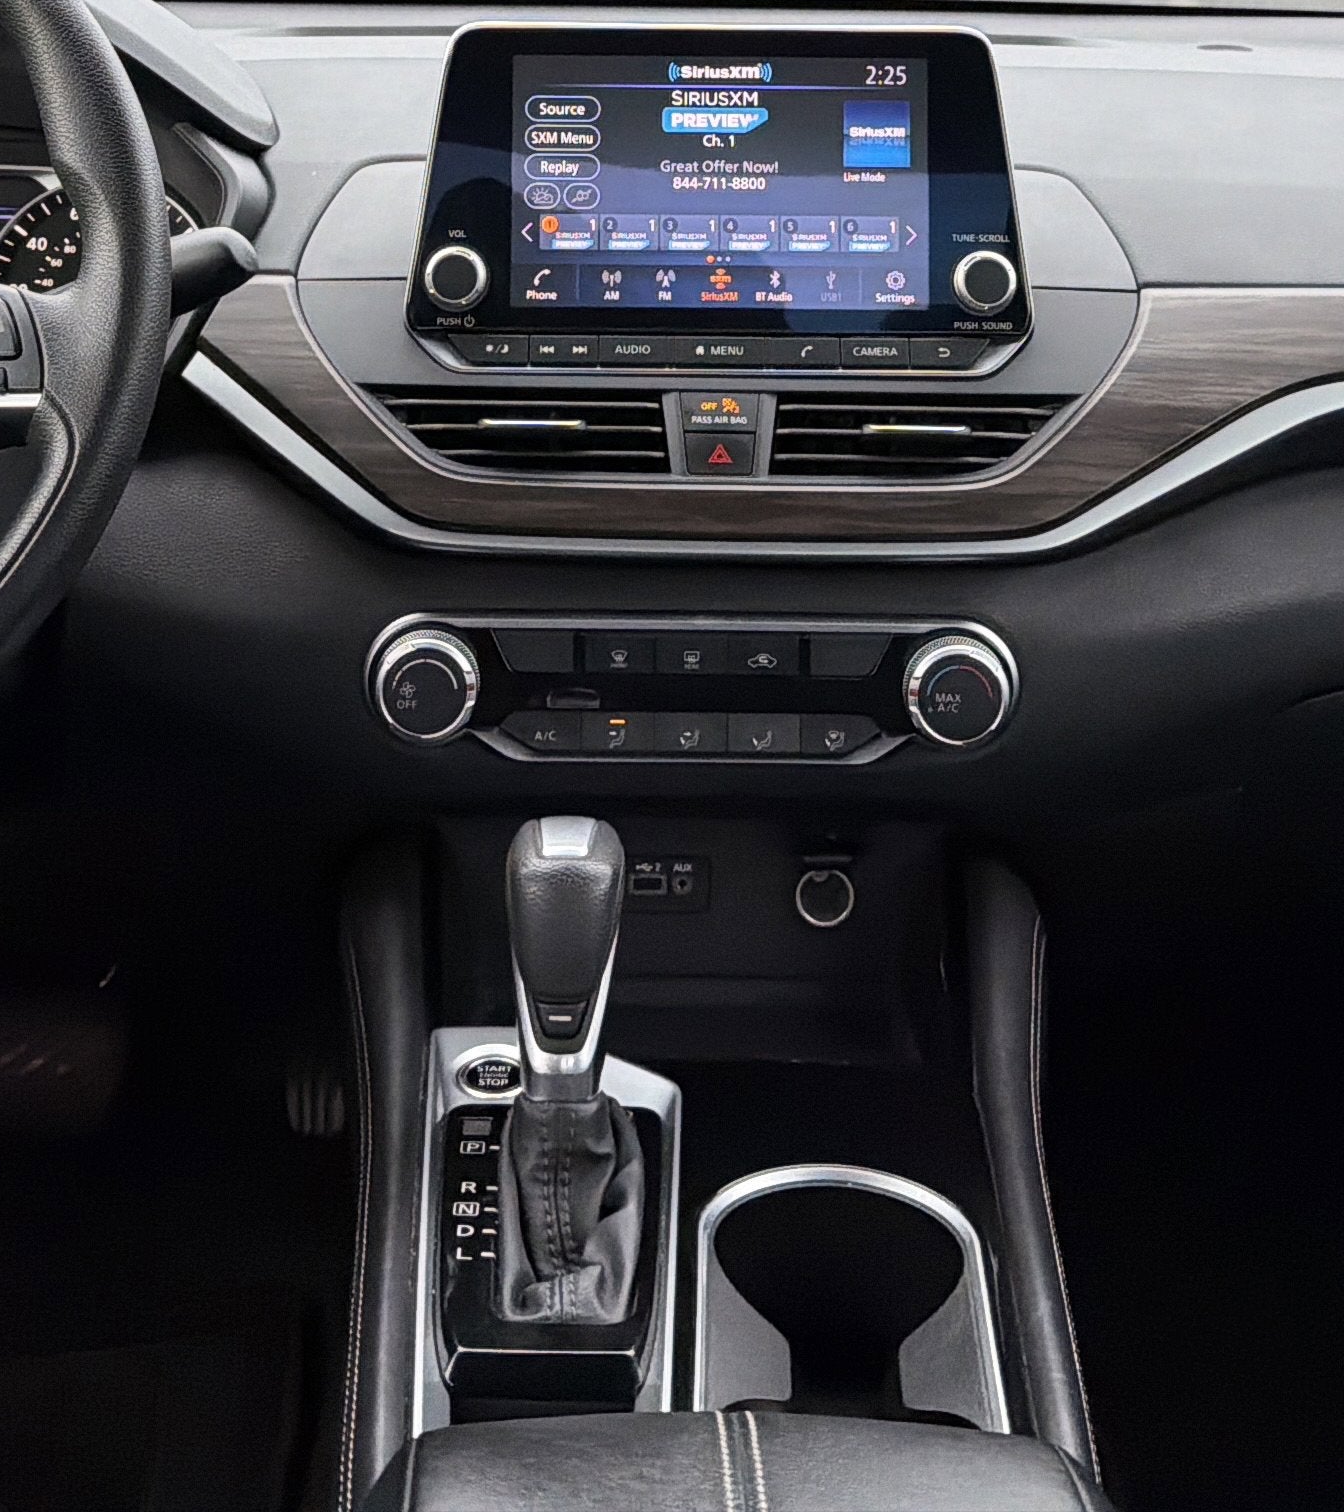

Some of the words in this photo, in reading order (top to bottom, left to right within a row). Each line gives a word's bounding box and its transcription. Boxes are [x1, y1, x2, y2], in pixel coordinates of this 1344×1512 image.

[865, 65, 907, 86] 2:25
[671, 90, 759, 106] SIRIUSXM
[539, 102, 586, 117] Source
[670, 112, 759, 128] PREVIEW
[531, 131, 557, 145] SXM
[560, 131, 594, 145] Menu
[702, 135, 725, 148] Ch.
[728, 135, 735, 148] 1
[540, 160, 580, 176] Replay
[659, 159, 700, 174] Great
[701, 159, 740, 174] Offer
[742, 159, 779, 174] Now!
[672, 176, 766, 190] 844-711-8800
[861, 172, 886, 183] Mode
[589, 218, 596, 232] 1
[606, 219, 613, 230] 2
[649, 218, 656, 232] 1
[666, 220, 674, 231] 3
[709, 219, 716, 233] 1
[726, 220, 734, 231] 4
[769, 219, 776, 233] 1
[787, 221, 794, 231] 5
[829, 219, 836, 234] 1
[847, 221, 854, 232] 6
[889, 220, 896, 234] 1
[448, 229, 467, 239] VOL
[26, 237, 48, 251] 40
[63, 244, 77, 255] 80
[50, 258, 63, 268] 60
[41, 278, 54, 287] 40
[526, 290, 558, 301] Phone
[603, 291, 620, 301] AM
[658, 291, 672, 301] FM
[701, 291, 739, 302] SiriusXM
[755, 292, 766, 302] BT
[767, 292, 793, 303] Audio
[875, 292, 916, 305] Settings
[436, 316, 462, 327] PUSH
[953, 321, 979, 330] PUSH
[982, 321, 1013, 331] SOUND
[614, 344, 651, 355] AUDIO
[710, 345, 745, 356] MENU
[852, 346, 899, 357] CAMERA
[700, 401, 718, 411] OFF
[691, 415, 713, 424] PASS
[713, 415, 729, 424] AIR
[730, 416, 748, 425] BAG
[935, 692, 962, 703] MAX
[396, 699, 418, 710] OFF
[937, 703, 960, 713] A/C
[534, 730, 557, 741] A/C
[672, 863, 693, 873] AUX
[476, 1065, 512, 1073] START
[478, 1078, 509, 1087] STOP
[466, 1143, 480, 1153] P
[460, 1181, 477, 1194] R
[458, 1204, 474, 1215] N
[456, 1224, 475, 1237] D
[456, 1246, 473, 1260] L
